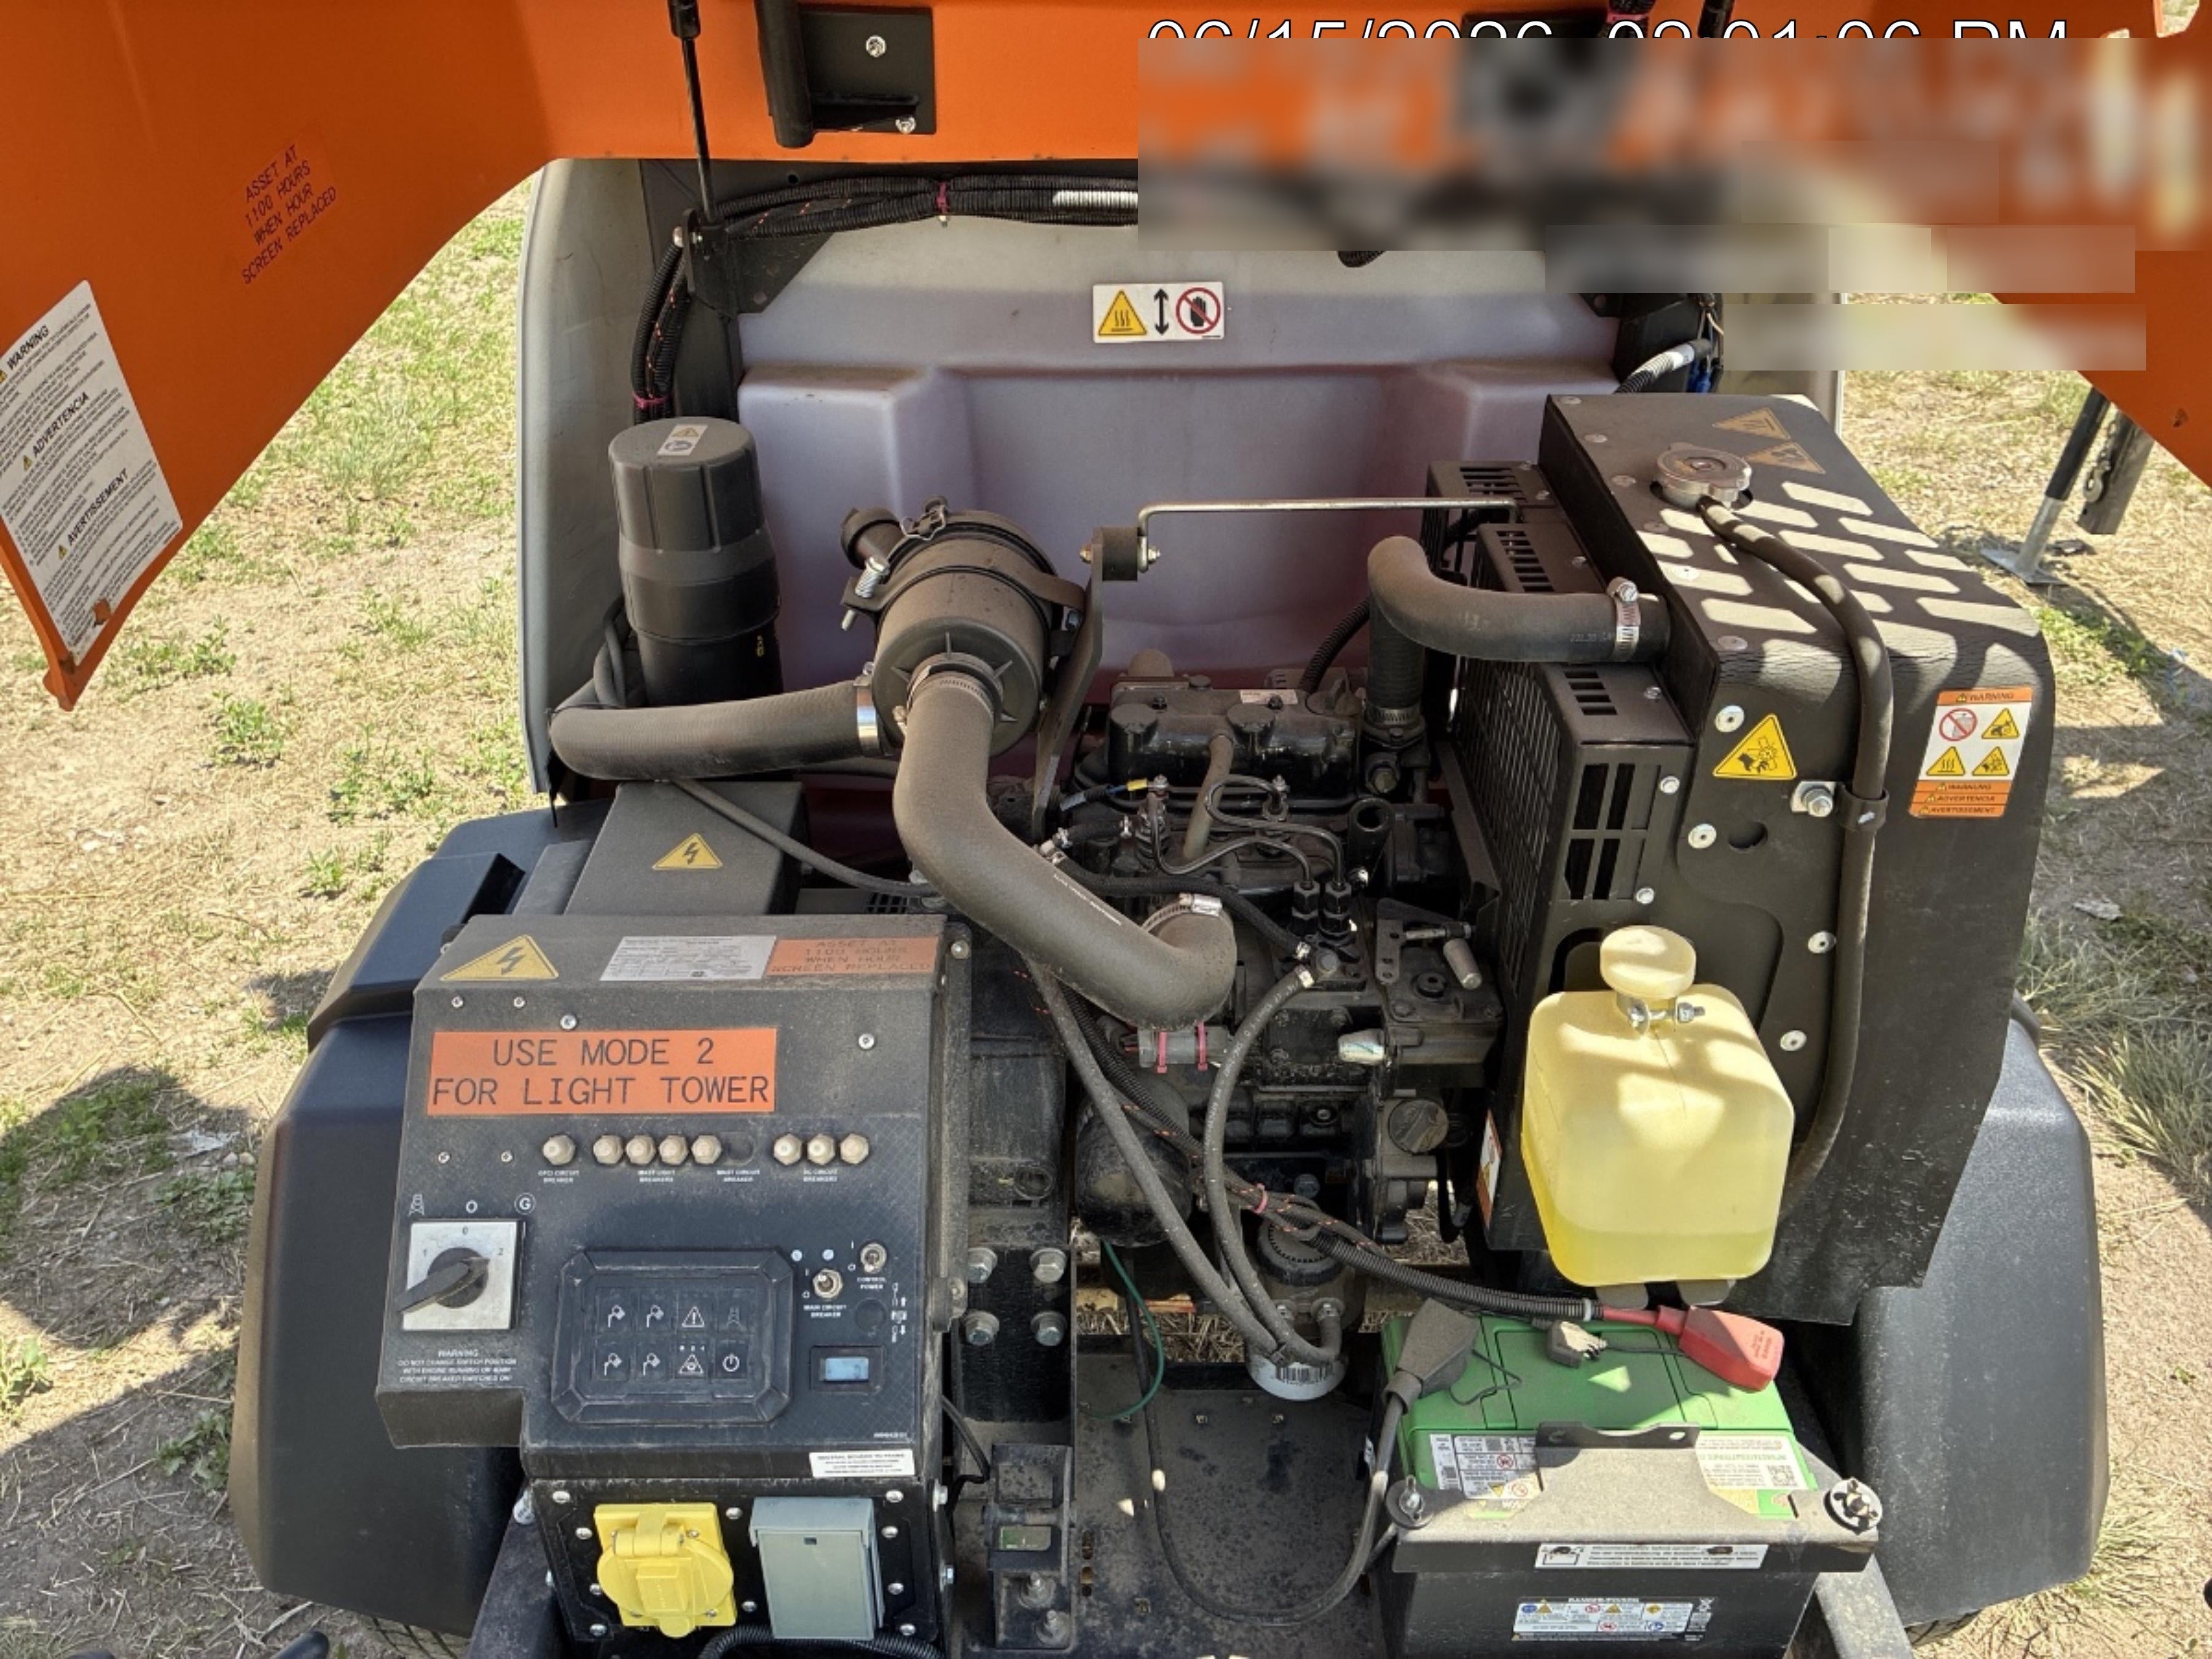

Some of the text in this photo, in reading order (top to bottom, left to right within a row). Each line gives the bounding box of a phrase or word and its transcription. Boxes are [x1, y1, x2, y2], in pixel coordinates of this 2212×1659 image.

[245, 160, 310, 228] 1100 HOURS
[246, 143, 297, 203] ASSET AT
[241, 186, 336, 284] SCREEN REPLACED
[254, 182, 313, 246] WHEN HOUR
[7, 323, 49, 371] WARNING
[33, 391, 89, 458] ADVERTENCIA
[67, 467, 128, 546] AVERTISSEMENT
[1969, 692, 2014, 702] WARNING
[493, 1037, 715, 1066] USE MODE 2
[433, 1075, 769, 1105] FOR LIGHT TOWER
[519, 1198, 531, 1210] G
[497, 1247, 504, 1256] 2
[437, 1349, 479, 1357] WARNING
